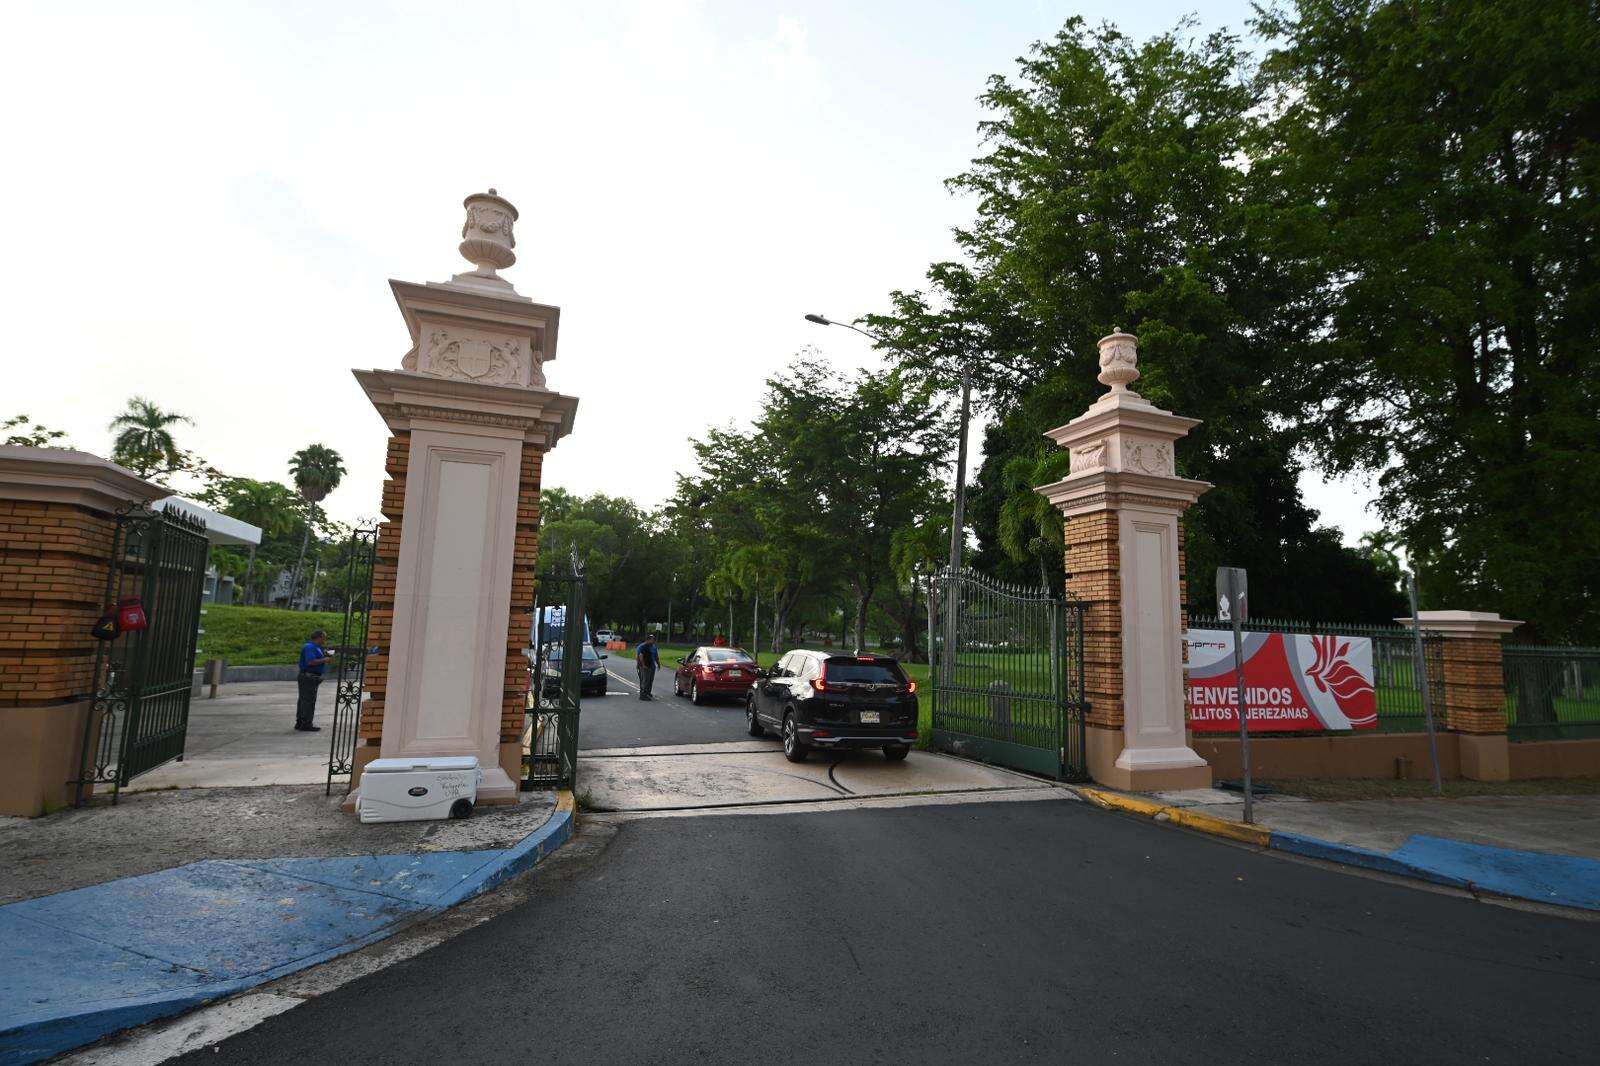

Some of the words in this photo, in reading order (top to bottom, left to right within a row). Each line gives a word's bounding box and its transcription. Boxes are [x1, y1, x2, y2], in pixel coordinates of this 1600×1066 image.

[1185, 686, 1292, 705] IENVENIDOS
[1190, 707, 1232, 720] LLITOS
[1245, 707, 1308, 720] JEREZANAS
